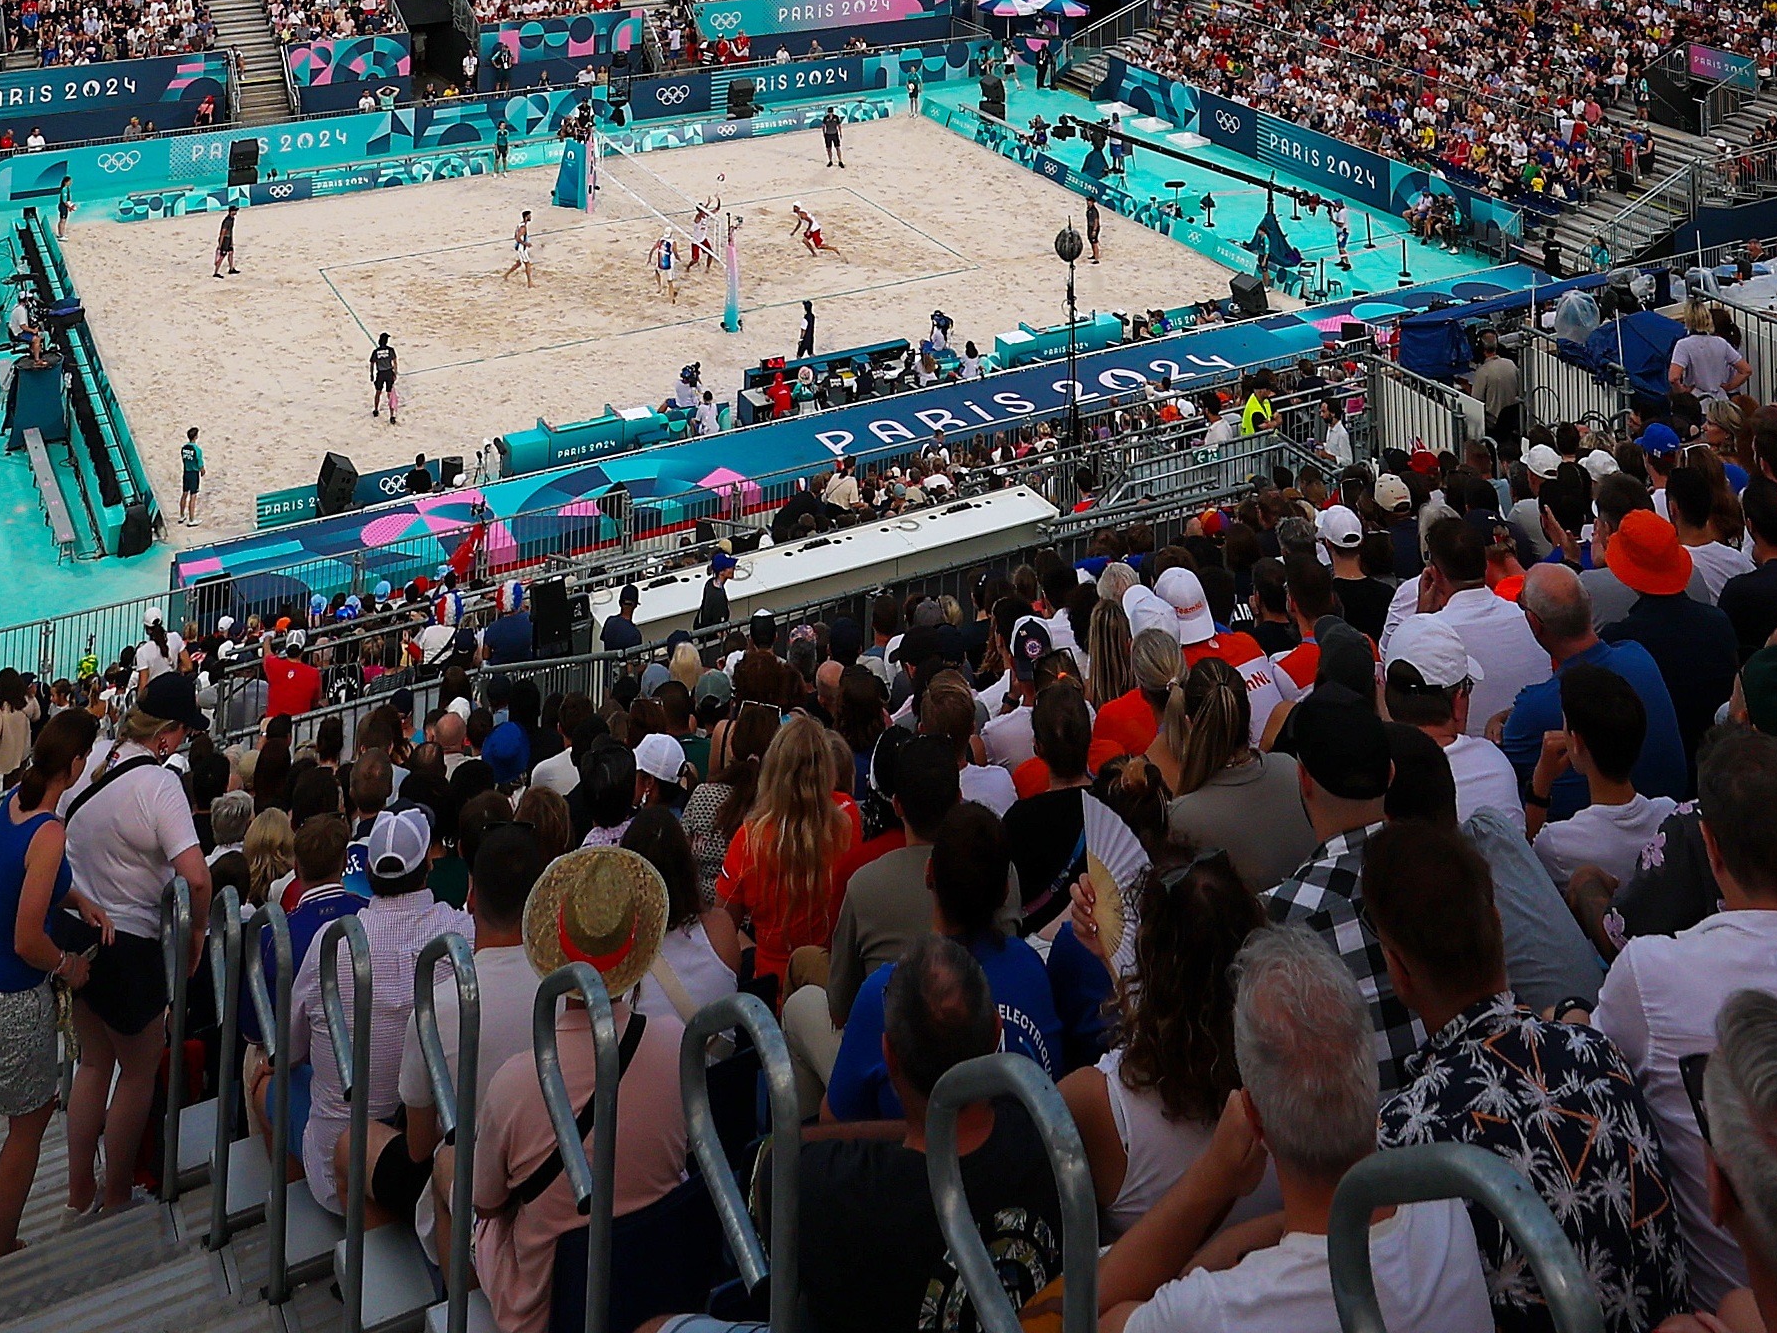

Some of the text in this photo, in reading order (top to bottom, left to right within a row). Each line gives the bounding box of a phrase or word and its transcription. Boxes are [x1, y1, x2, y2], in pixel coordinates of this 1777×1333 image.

[64, 77, 138, 99] 2024
[796, 69, 848, 89] 2024
[279, 128, 348, 151] 2024
[345, 176, 369, 187] 2024
[1327, 155, 1377, 190] 2024
[1052, 353, 1237, 404] 2024
[589, 440, 616, 452] 2024
[998, 1003, 1063, 1081] ELECTRIQU
